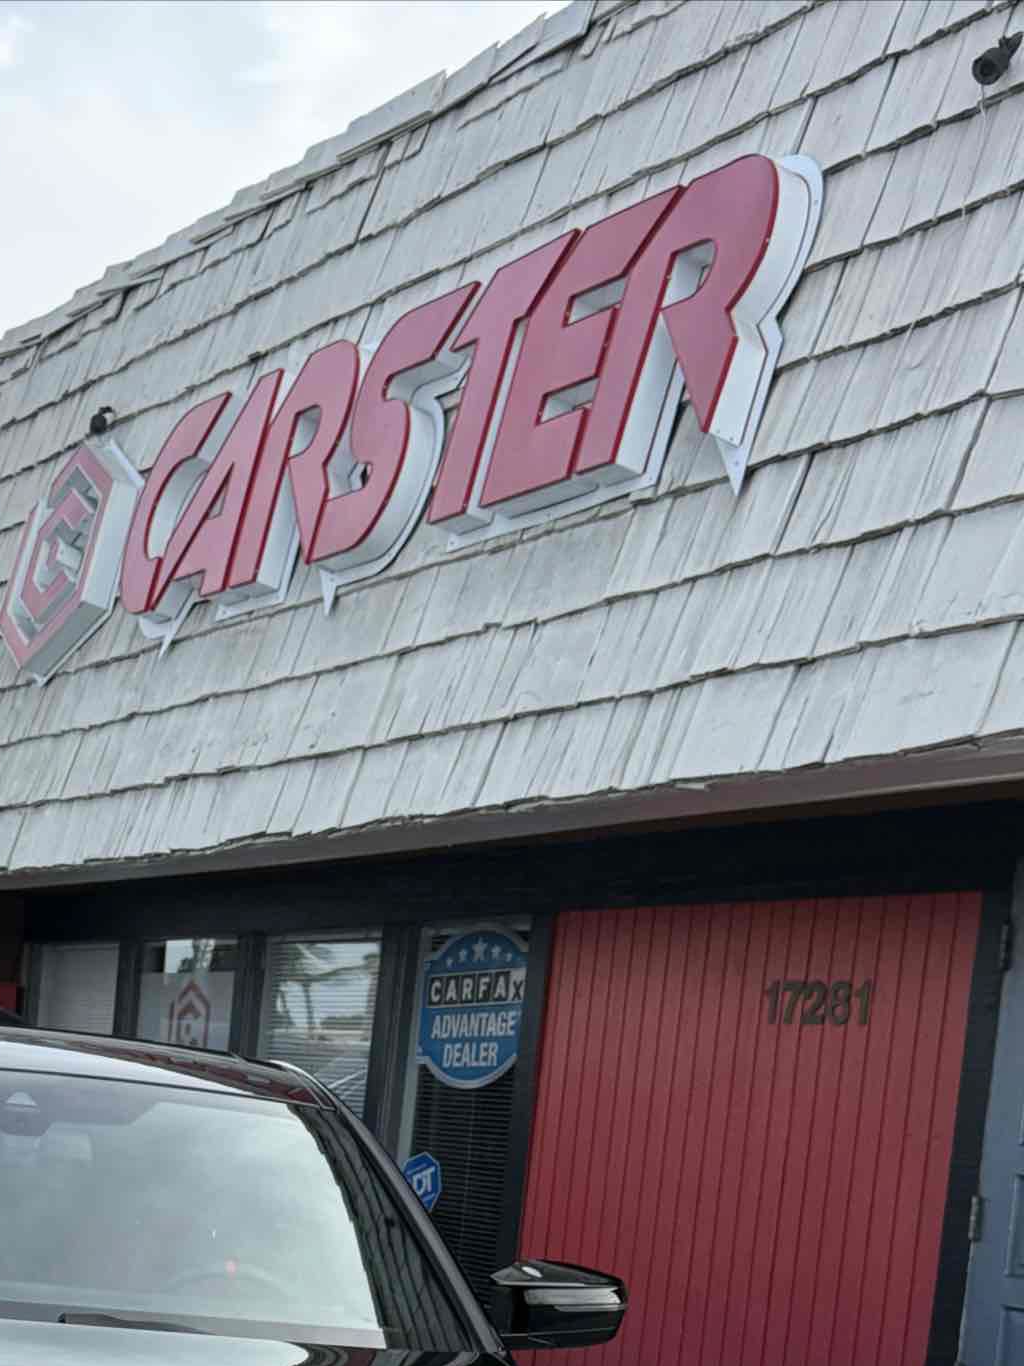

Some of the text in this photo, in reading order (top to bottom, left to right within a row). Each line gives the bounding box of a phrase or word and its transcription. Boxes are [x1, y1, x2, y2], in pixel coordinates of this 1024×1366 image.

[120, 153, 790, 616] CARSTER
[431, 975, 524, 1002] CARFAX
[768, 980, 871, 1025] 17281
[431, 1010, 517, 1039] ADVANTAGE
[442, 1042, 499, 1068] DEALER
